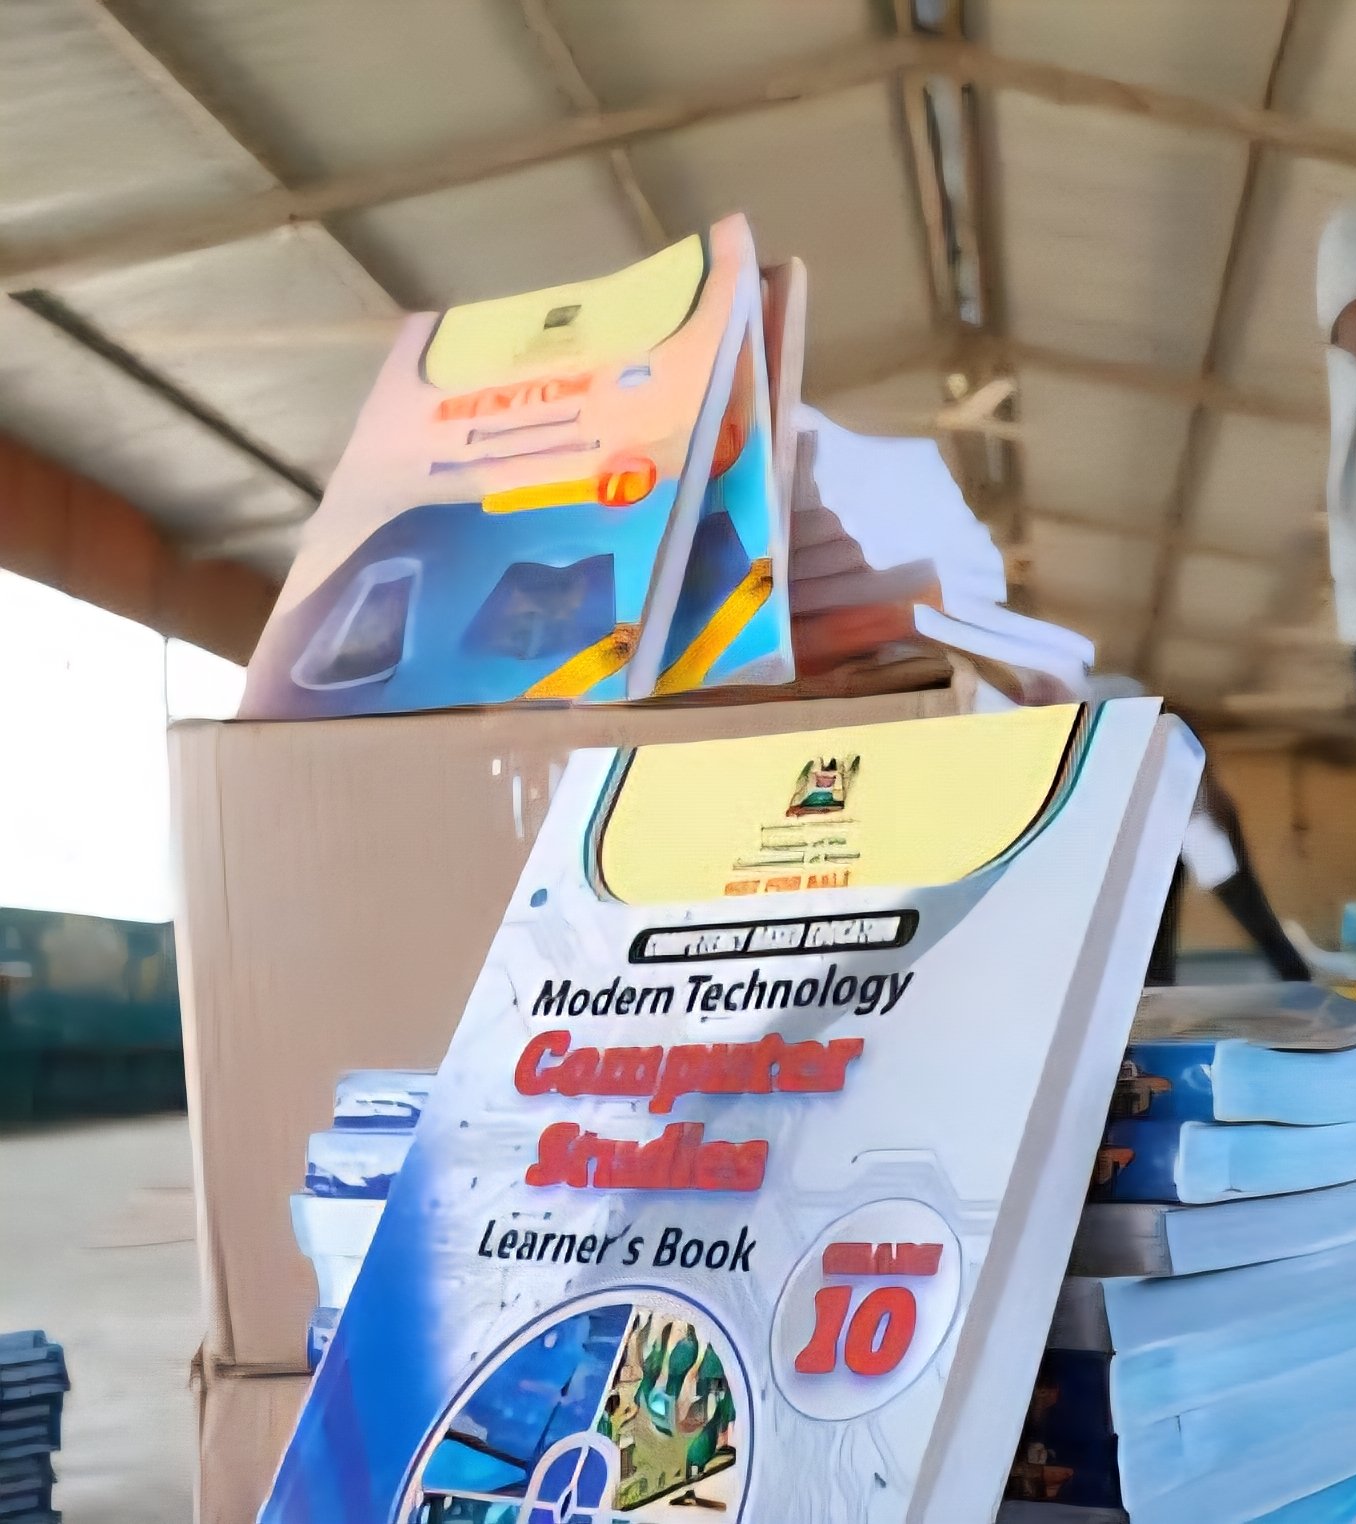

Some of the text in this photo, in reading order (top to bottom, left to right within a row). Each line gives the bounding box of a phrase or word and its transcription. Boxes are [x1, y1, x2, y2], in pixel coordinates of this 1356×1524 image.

[531, 963, 915, 1017] Modern Technology
[477, 1218, 757, 1272] Learner's Book
[794, 1285, 917, 1376] 10
